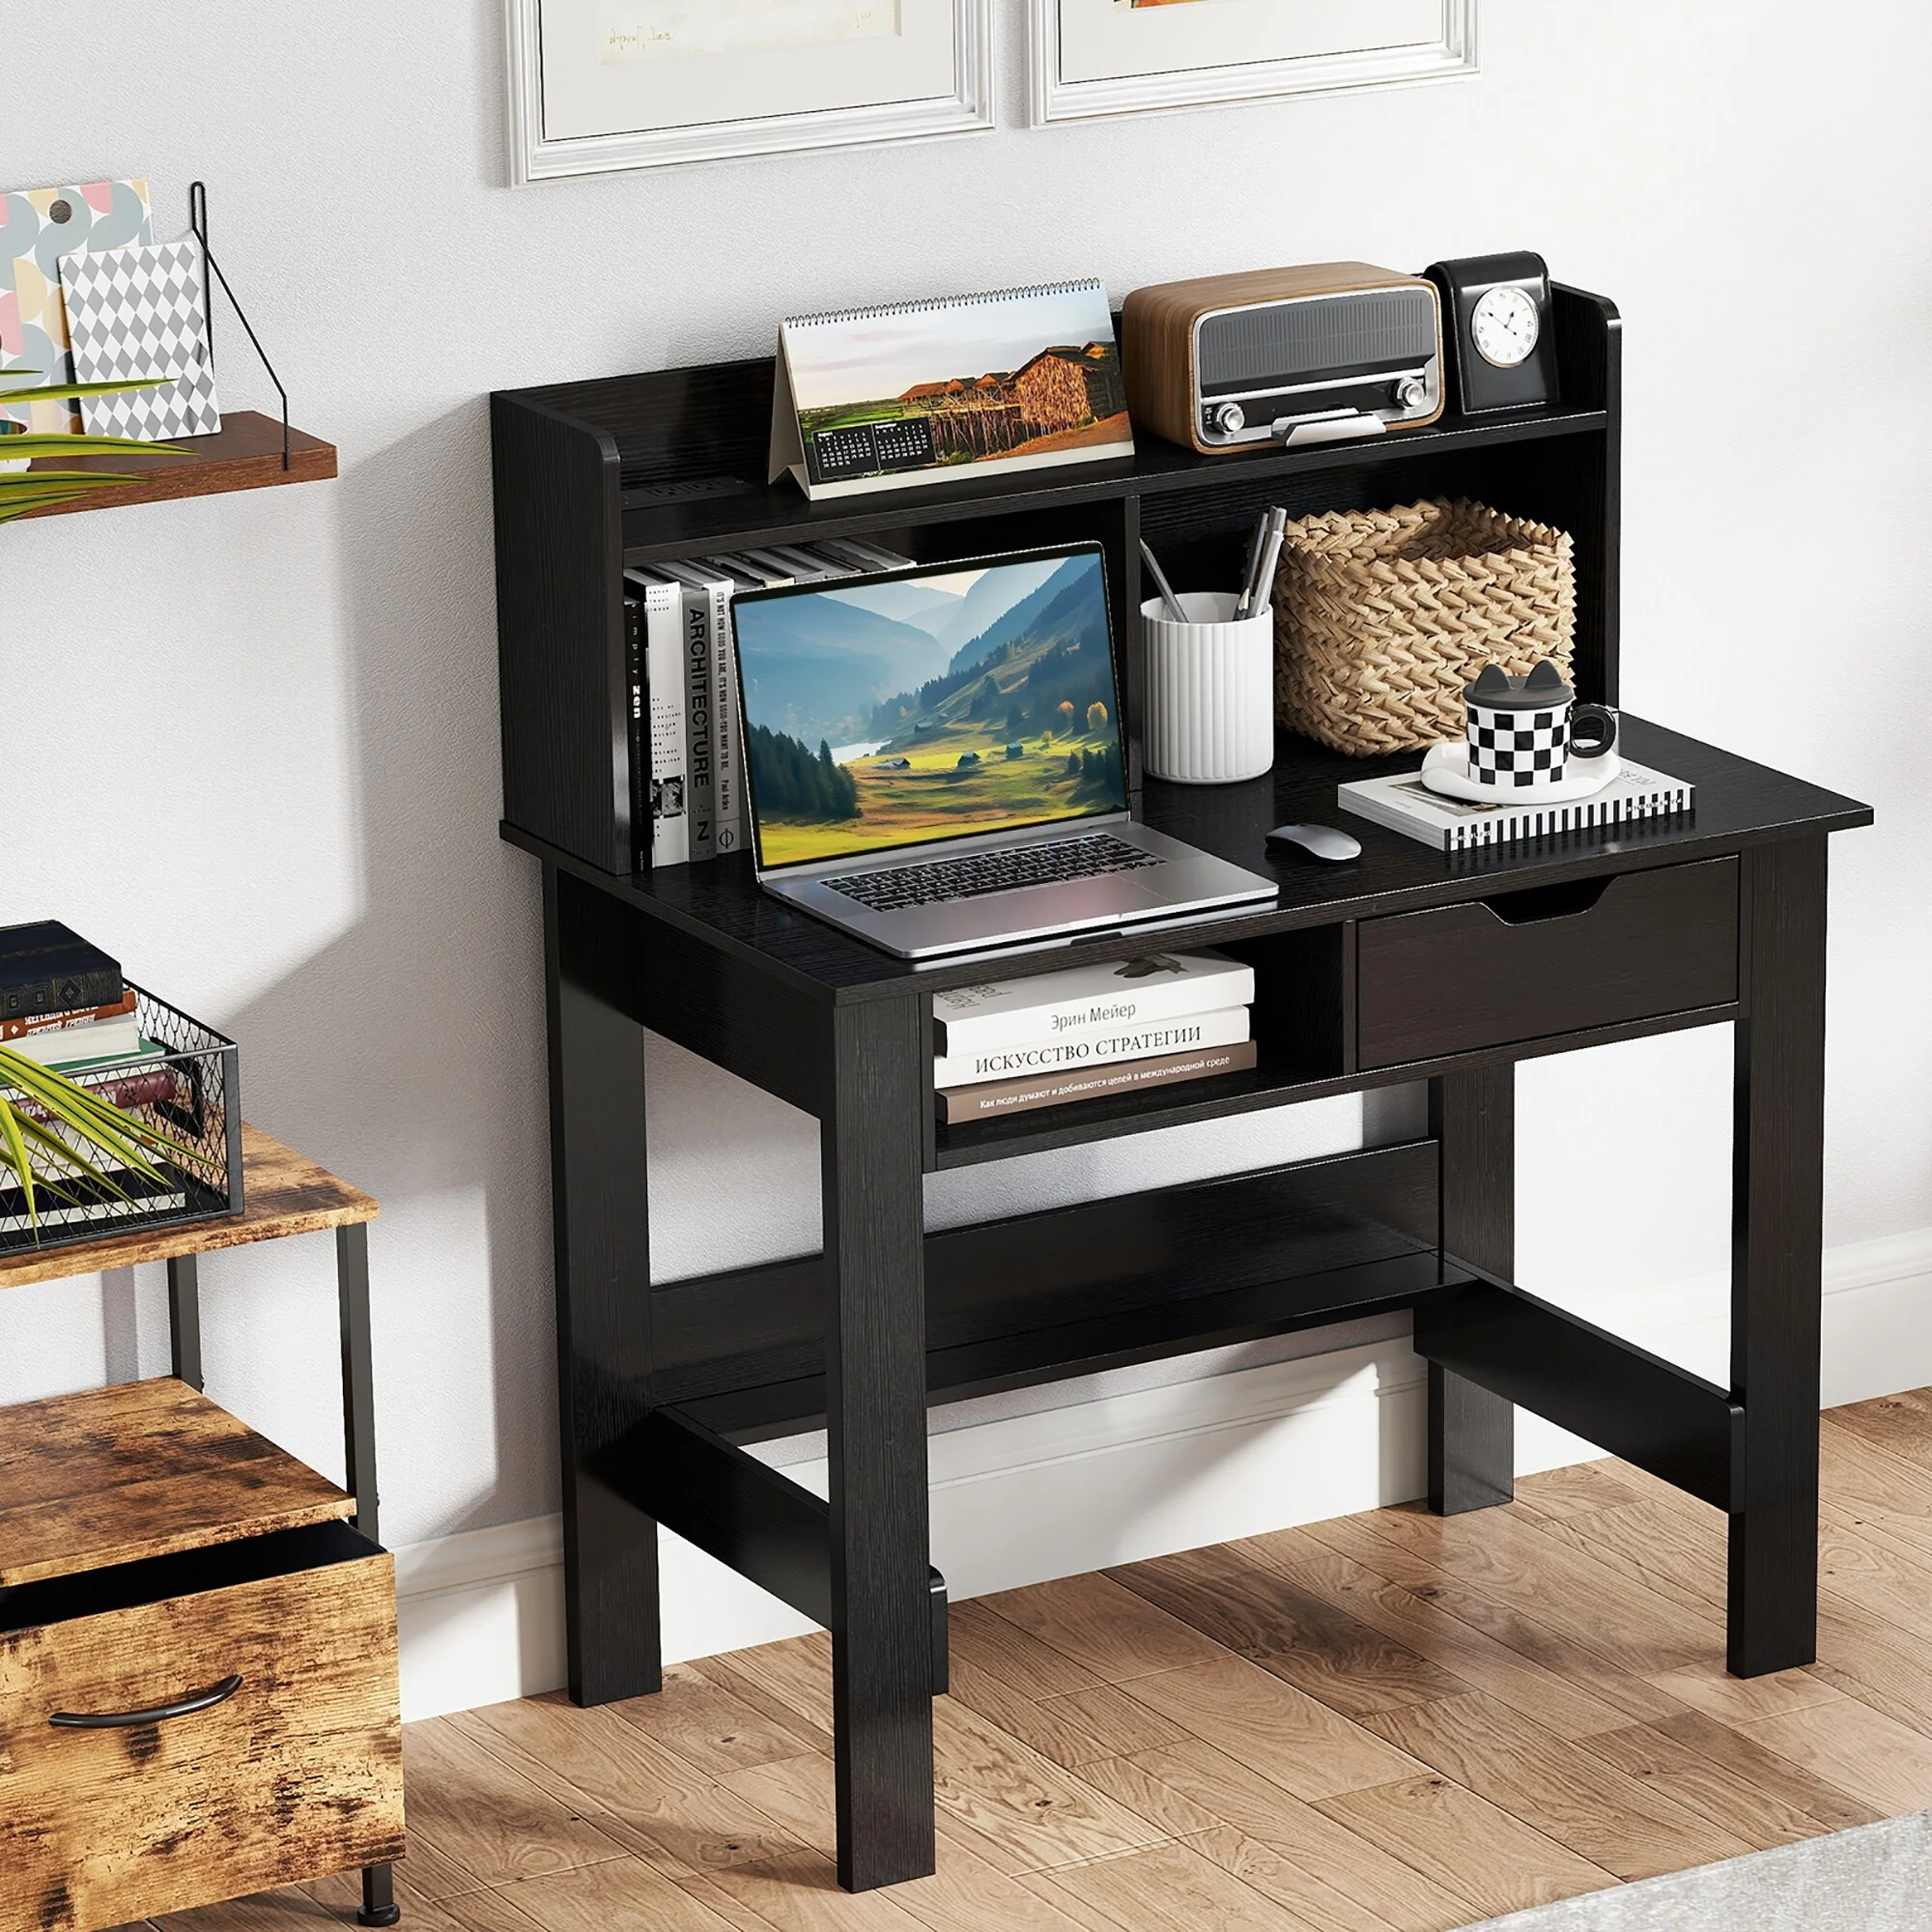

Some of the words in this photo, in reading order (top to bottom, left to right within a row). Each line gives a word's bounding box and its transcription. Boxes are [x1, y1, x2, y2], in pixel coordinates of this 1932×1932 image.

[632, 685, 641, 719] zen
[689, 608, 710, 788] ARCHITECTURE
[721, 780, 730, 793] Paul
[1051, 1012, 1086, 1032] Эрин
[1090, 1004, 1136, 1023] Мейер
[975, 1042, 1090, 1074] ИСКУССТВО
[1095, 1026, 1201, 1056] СТРАТЕГИИ
[980, 1099, 995, 1109] Как
[995, 1095, 1018, 1107] люди
[1018, 1090, 1050, 1103] думают
[1051, 1088, 1058, 1096] и
[1058, 1078, 1107, 1096] добиваются
[1107, 1072, 1132, 1087] целей
[1140, 1059, 1205, 1079] международной
[1207, 1056, 1231, 1068] среде
